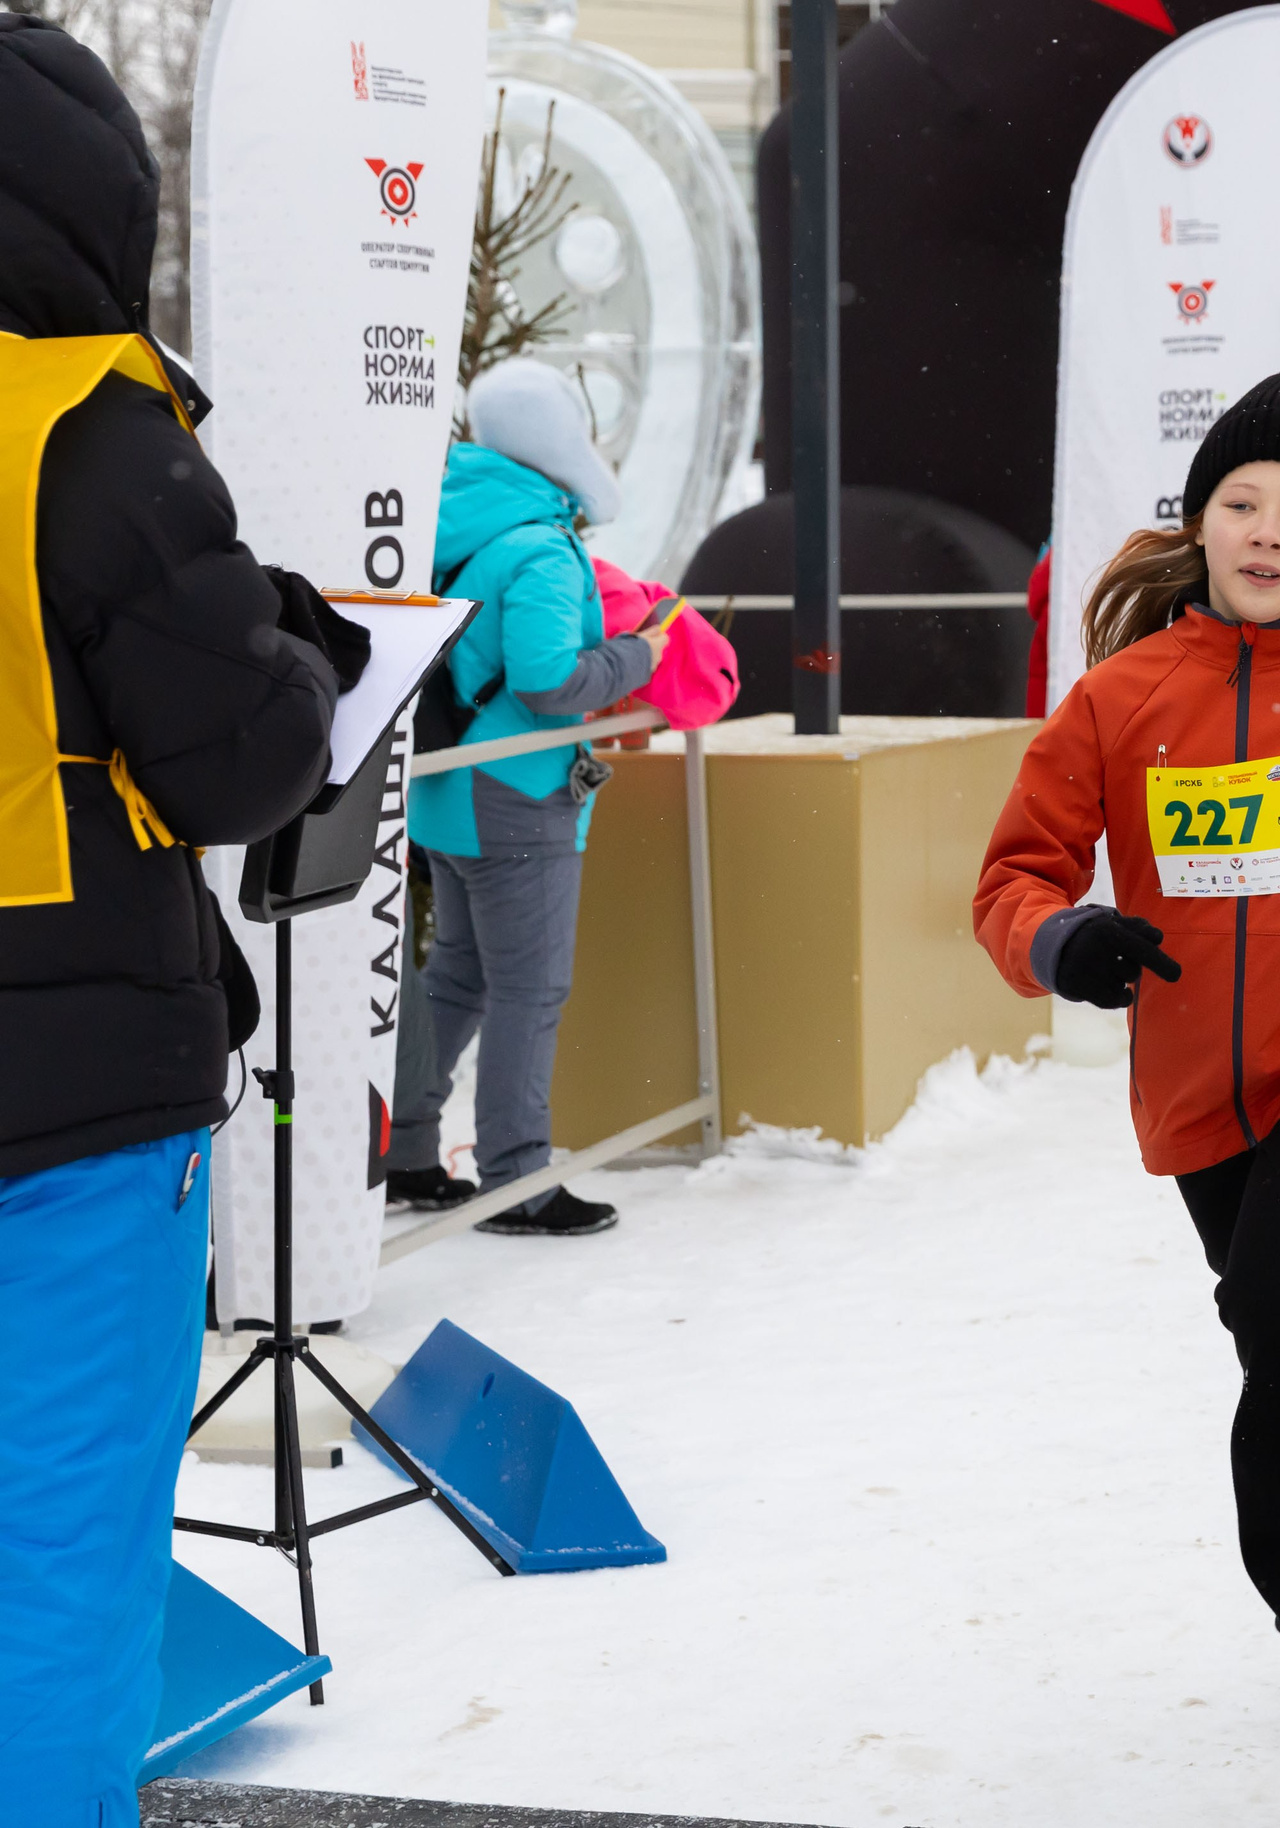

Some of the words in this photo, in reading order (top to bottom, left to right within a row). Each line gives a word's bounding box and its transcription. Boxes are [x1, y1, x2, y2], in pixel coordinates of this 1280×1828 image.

[363, 325, 425, 352] СПОРТ
[364, 353, 435, 381] НОРМА
[366, 381, 435, 410] ЖИЗНИ
[1158, 388, 1213, 406] СПОРТ
[1179, 779, 1203, 787] РСХБ
[1228, 777, 1252, 785] КУБОК
[1164, 793, 1264, 847] 227
